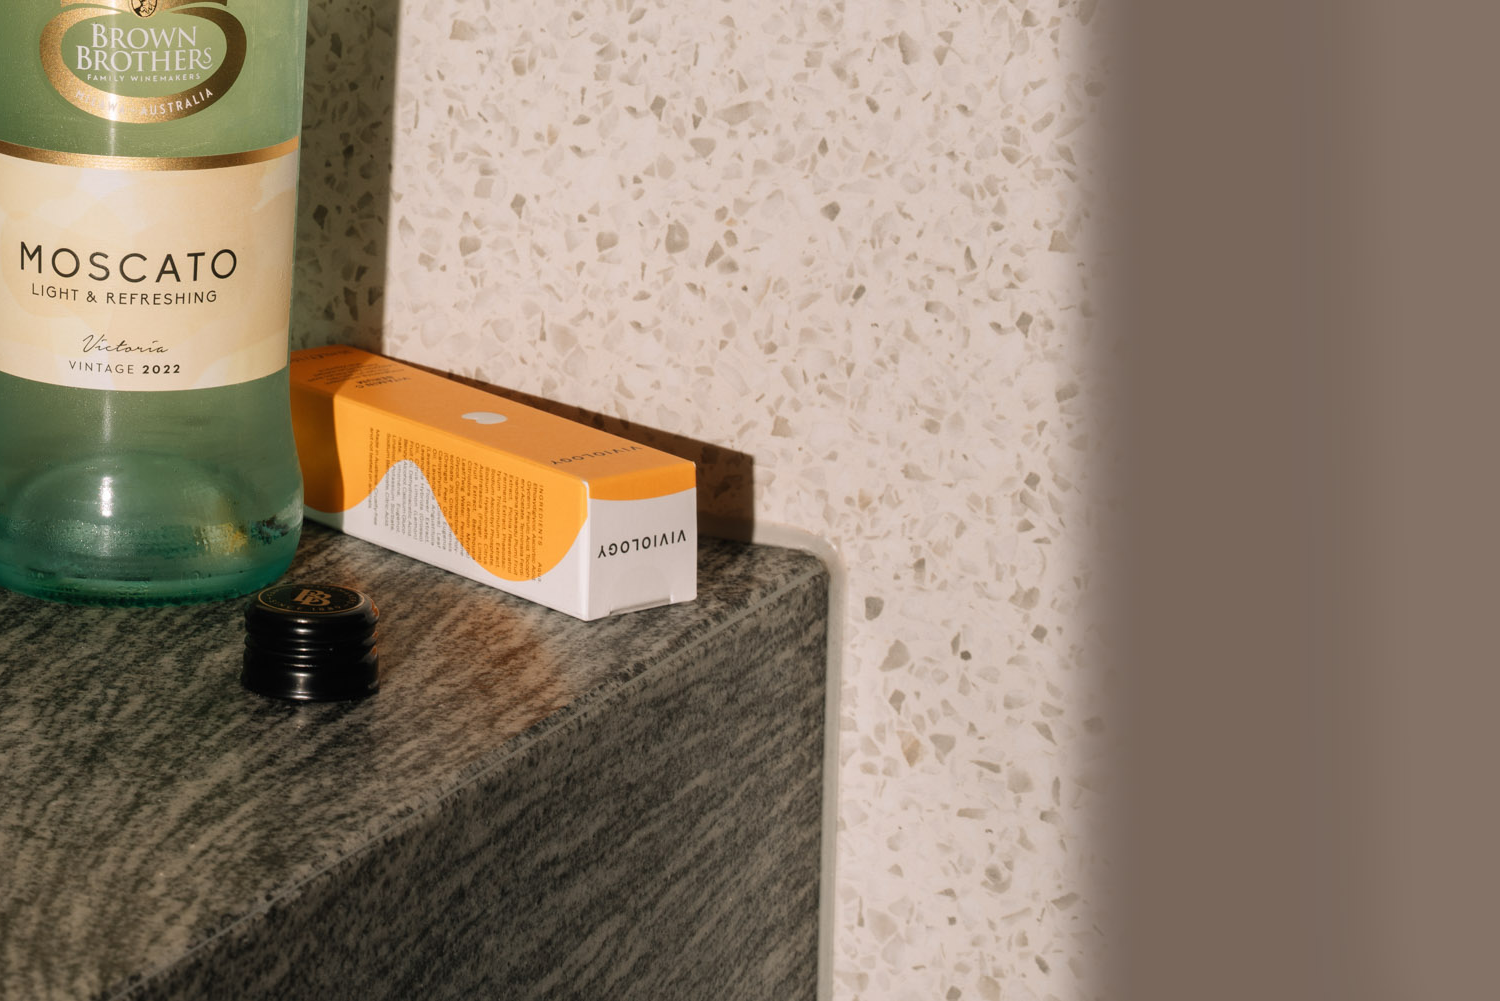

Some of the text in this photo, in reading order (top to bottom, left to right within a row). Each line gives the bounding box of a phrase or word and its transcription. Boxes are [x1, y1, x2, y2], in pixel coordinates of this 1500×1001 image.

[87, 73, 201, 82] FAMILY WINEMAKERS
[140, 87, 214, 116] AUSTRALIA
[19, 241, 238, 283] MOSCATO
[31, 282, 217, 305] LIGHT & REFRESHING
[82, 333, 169, 354] Victoria
[68, 360, 181, 374] VINTAGE 2022
[550, 446, 643, 465] VIVIOLOGY
[597, 529, 687, 559] VIVIOLOGY
